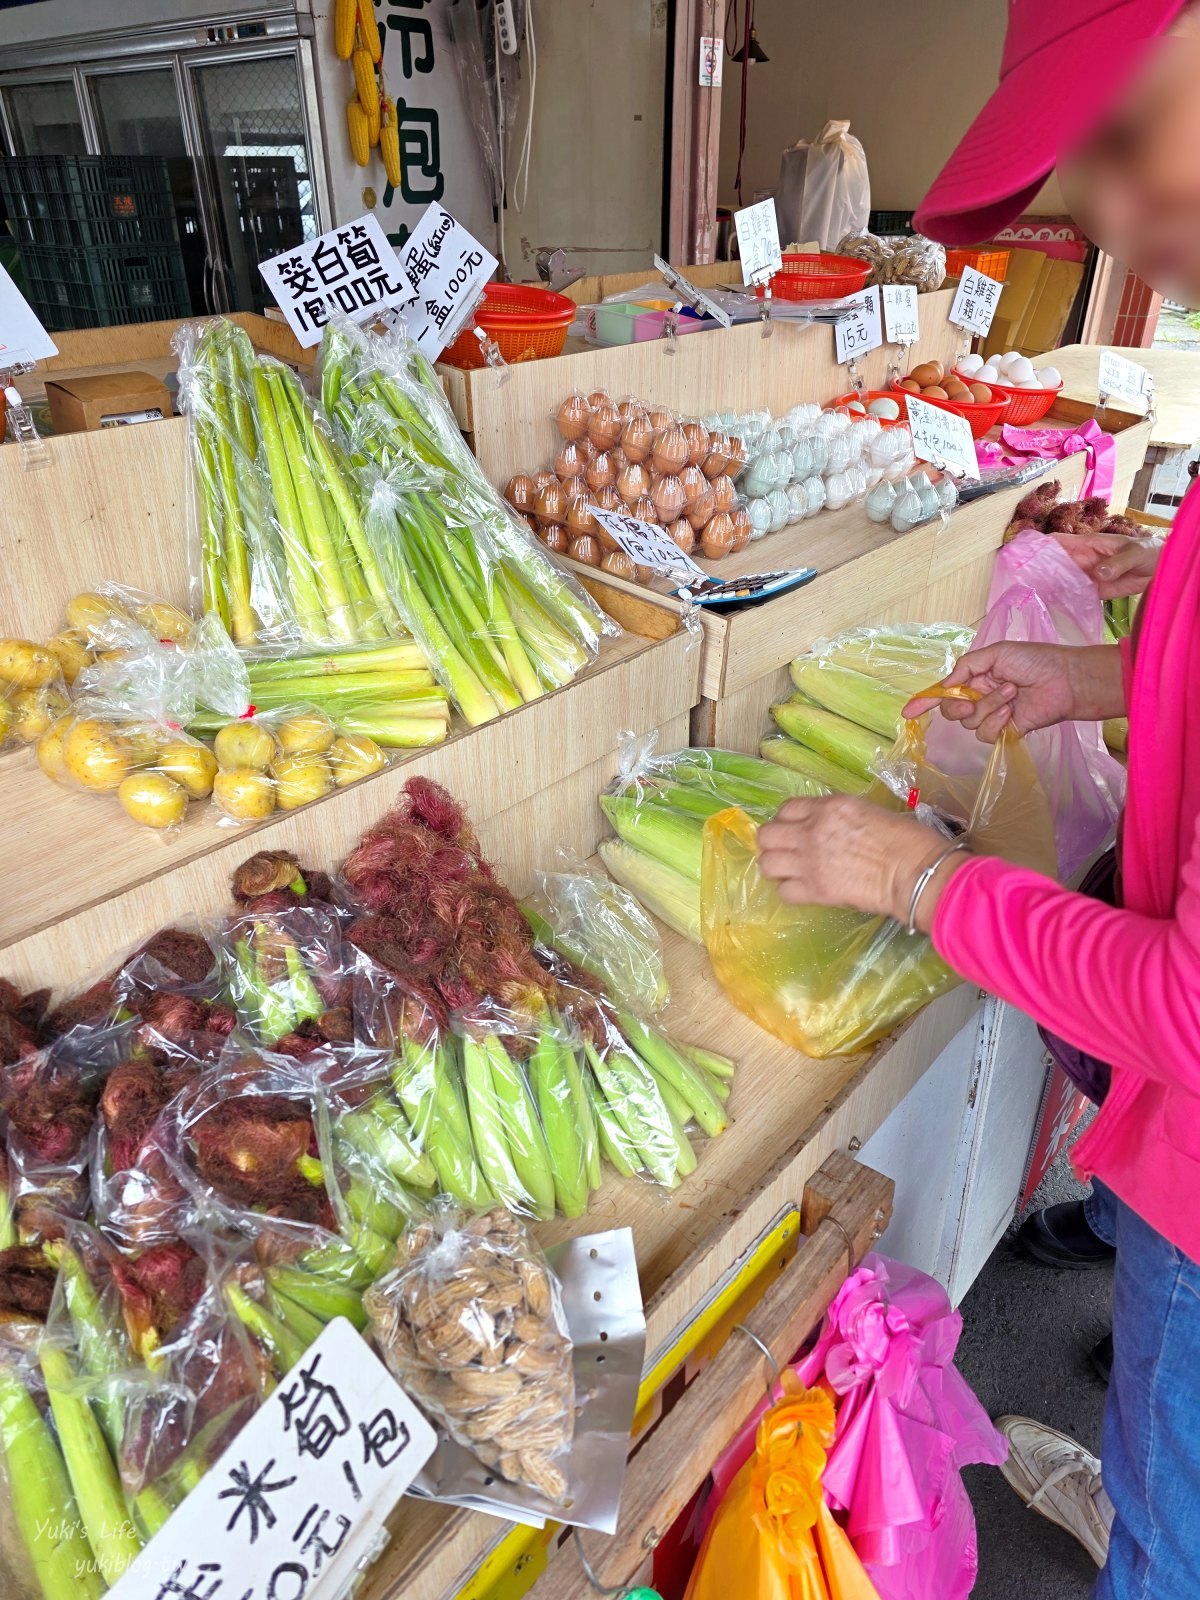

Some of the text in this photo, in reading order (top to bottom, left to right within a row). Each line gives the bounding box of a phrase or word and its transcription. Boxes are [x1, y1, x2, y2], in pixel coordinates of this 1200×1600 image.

[417, 250, 484, 342] 一盒100元
[842, 323, 868, 351] 15元
